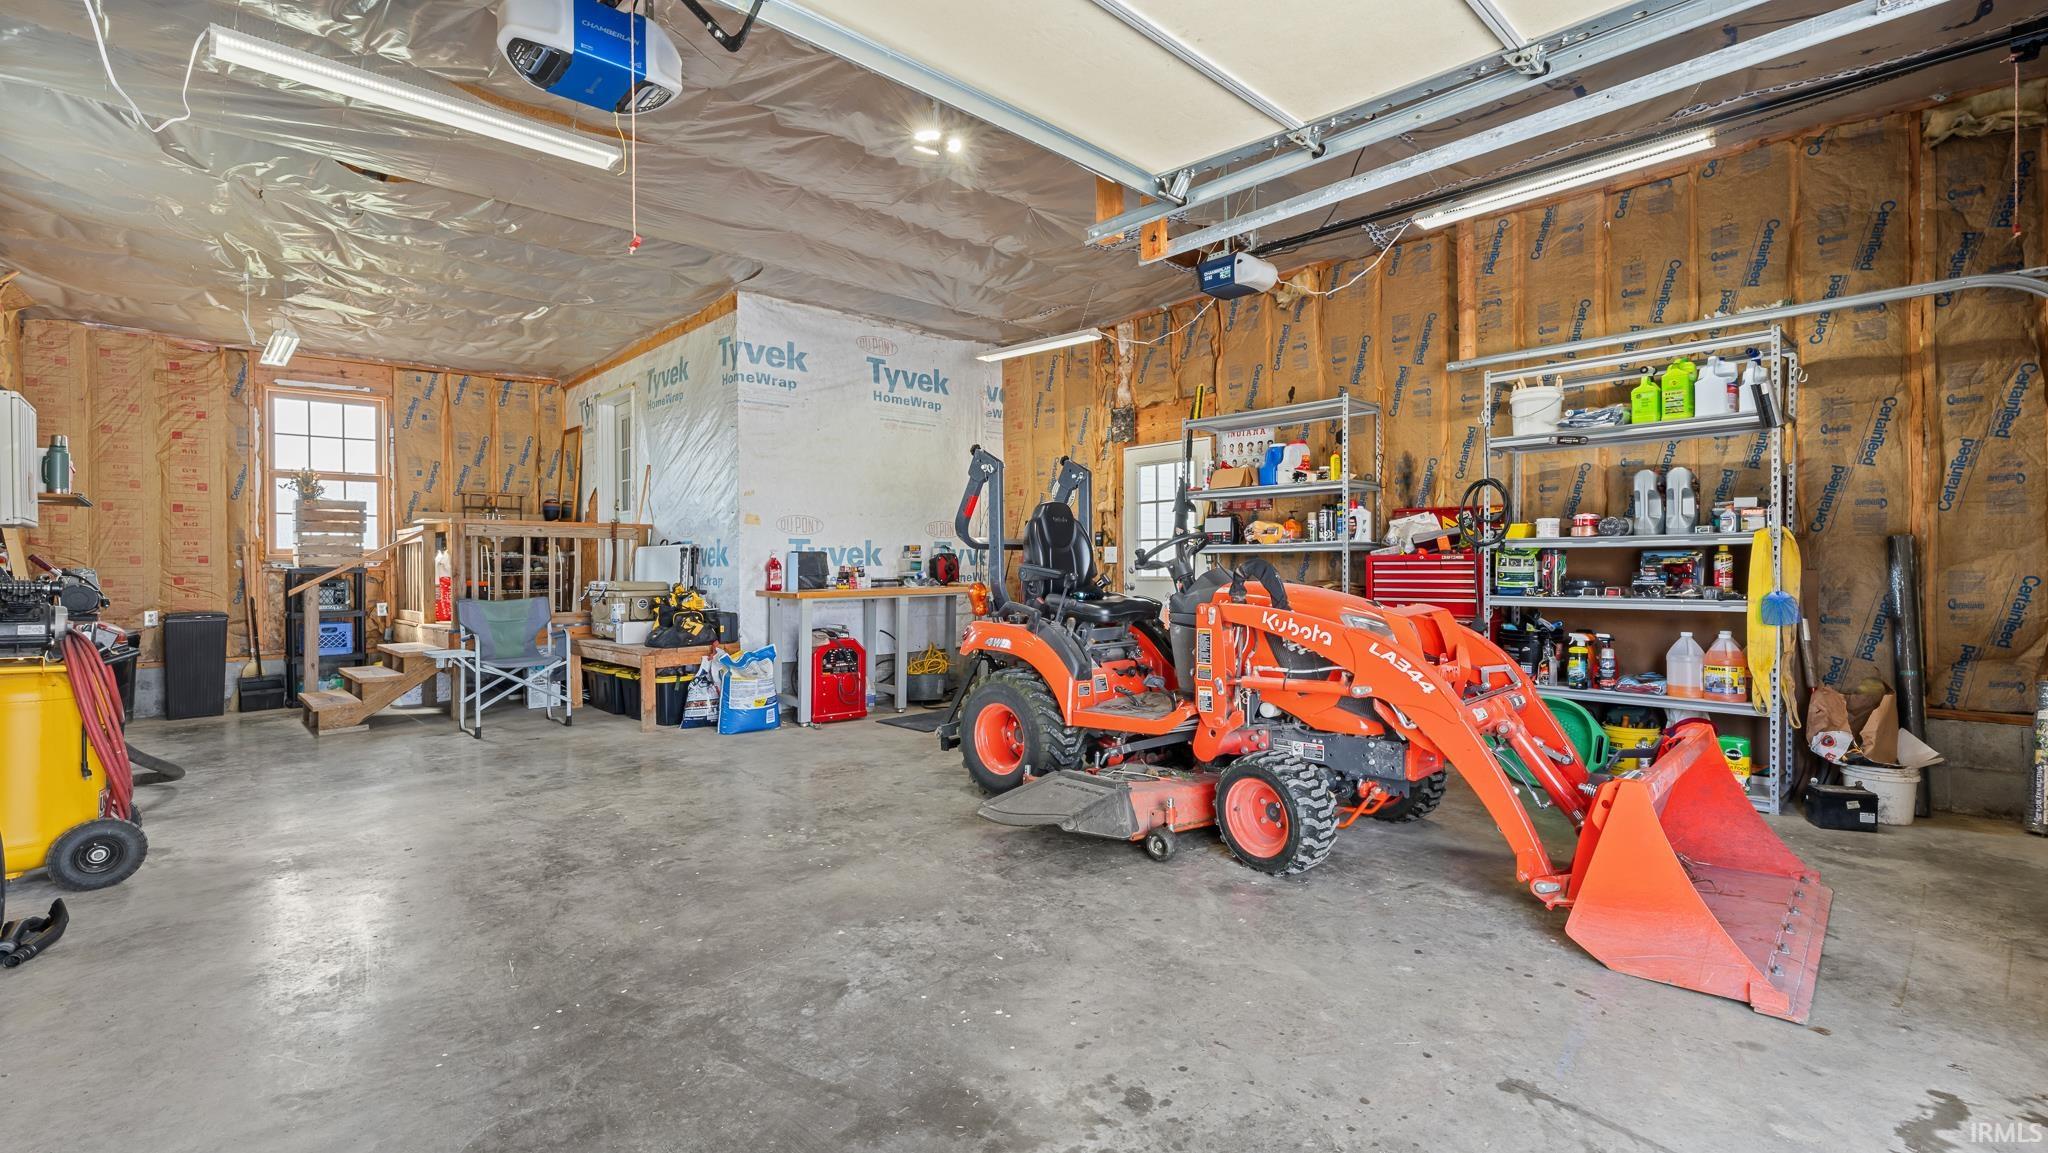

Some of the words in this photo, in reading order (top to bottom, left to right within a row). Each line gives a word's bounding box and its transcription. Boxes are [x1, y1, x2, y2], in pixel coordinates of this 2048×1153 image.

[581, 19, 640, 46] CHAMBERLAN
[1485, 218, 1509, 276] CertainTeed
[1747, 218, 1781, 288] CertainTeed
[1860, 200, 1897, 271] CertainTeed
[1653, 259, 1682, 325] CertainTeed
[647, 356, 690, 398] Tyvek
[718, 335, 809, 373] Tyvek
[866, 356, 950, 396] Tyvek
[1351, 335, 1372, 385] CertainTeed
[721, 372, 798, 391] HomeWrap
[872, 390, 942, 413] HomeWrap
[1388, 365, 1407, 418] CertainTeed
[1995, 362, 2039, 440] CertainTeed
[1226, 427, 1267, 439] INDIANA
[1455, 425, 1476, 480] CertainTeed
[1861, 396, 1898, 467] CertainTeed
[1566, 462, 1592, 520] CertainTeed
[1809, 464, 1845, 533] CertainTeed
[1938, 438, 1975, 512] CertainTeed
[1262, 611, 1332, 646] Kubota
[1997, 575, 2042, 649] CertainTeed
[1368, 641, 1438, 694] LA344
